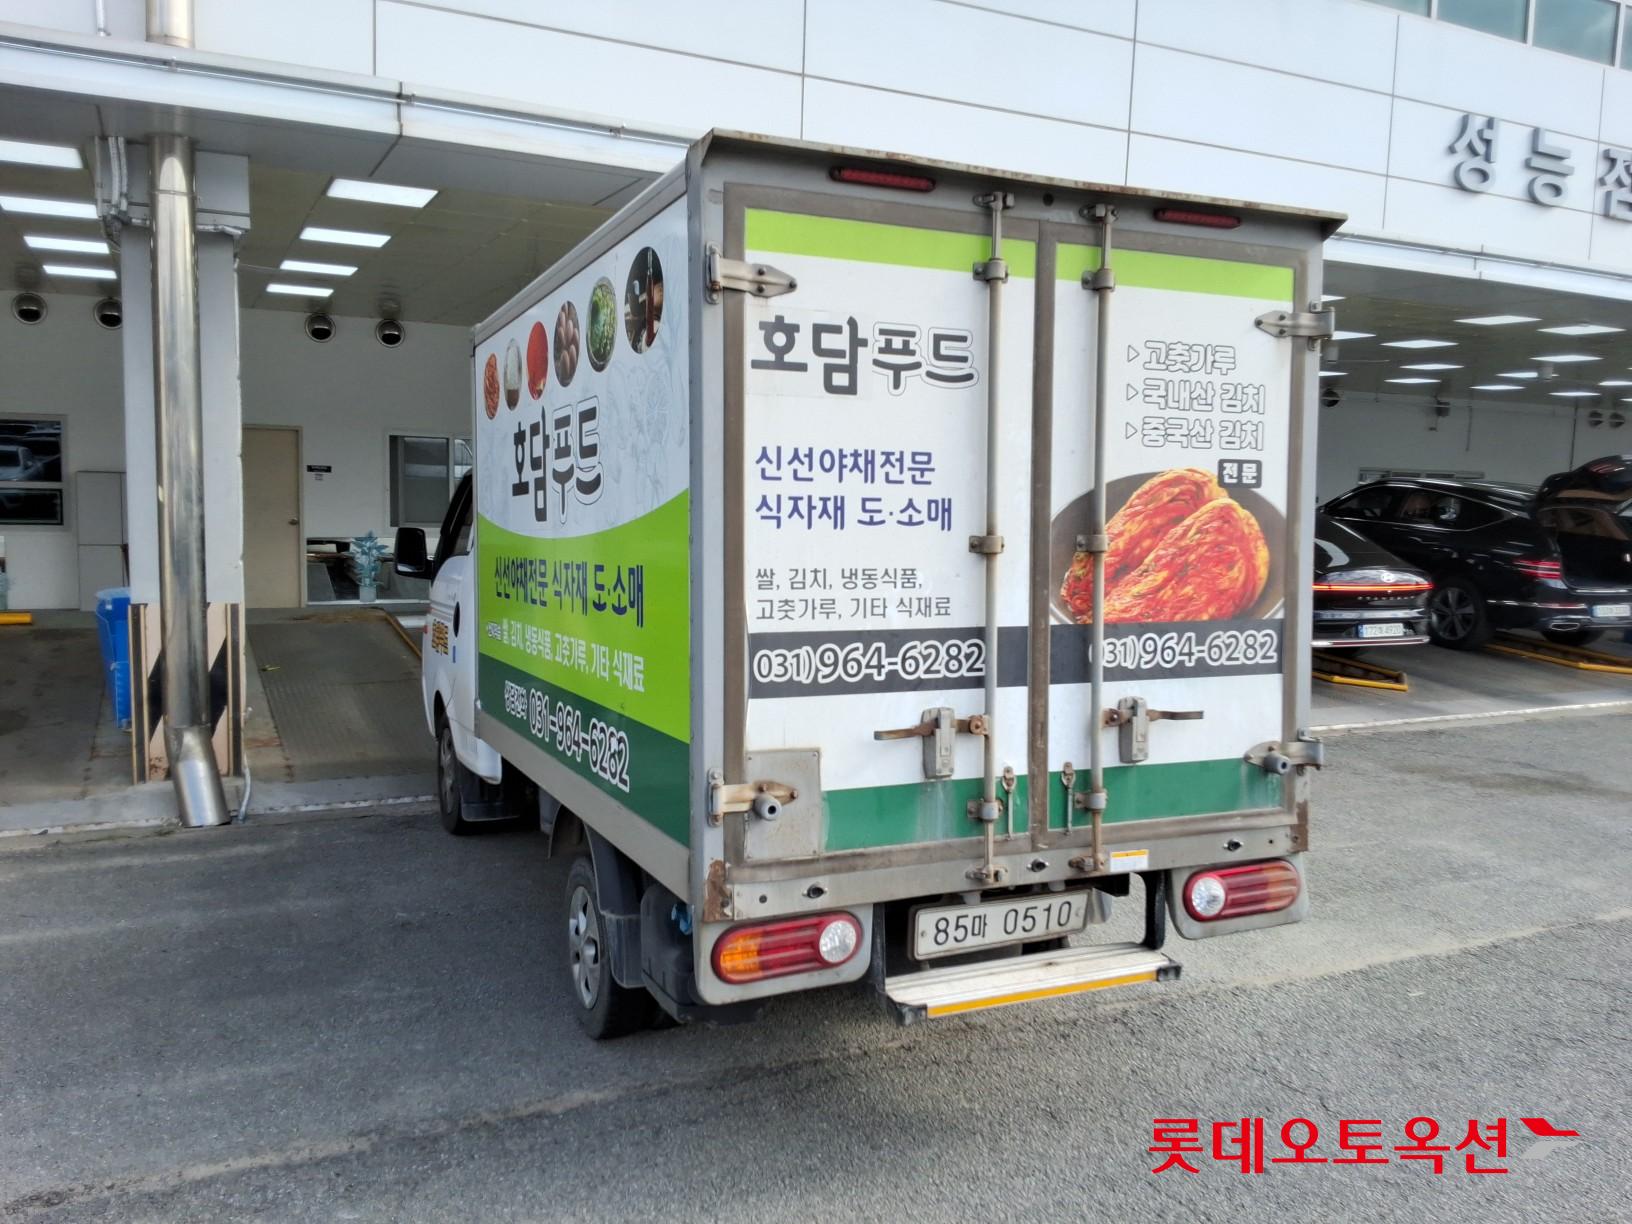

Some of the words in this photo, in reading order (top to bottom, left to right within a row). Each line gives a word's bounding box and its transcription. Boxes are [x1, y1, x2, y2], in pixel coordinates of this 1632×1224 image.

[750, 315, 979, 396] 호담푸드
[1143, 340, 1236, 375] 고춧가루
[1142, 378, 1215, 412] 국내산
[1220, 383, 1265, 414] 김치
[1141, 416, 1214, 449] 중국산
[1219, 420, 1264, 451] 김치
[512, 395, 604, 525] 호담푸드
[755, 446, 936, 485] 신선야채전문
[1223, 462, 1258, 484] 전문
[755, 494, 846, 530] 식자재
[494, 556, 548, 607] 신선야채전문
[552, 560, 588, 616] 식자재
[755, 568, 781, 590] 쌀,
[788, 568, 833, 590] 김치,
[840, 568, 923, 591] 냉동식품,
[755, 598, 843, 621] 고춧가루,
[849, 597, 888, 619] 기타
[895, 596, 952, 618] 식재료
[591, 643, 609, 682] 기타
[613, 649, 645, 693] 식재료
[753, 638, 986, 684] 031)964-6282
[934, 914, 987, 945] 85마
[1003, 901, 1072, 935] 0510
